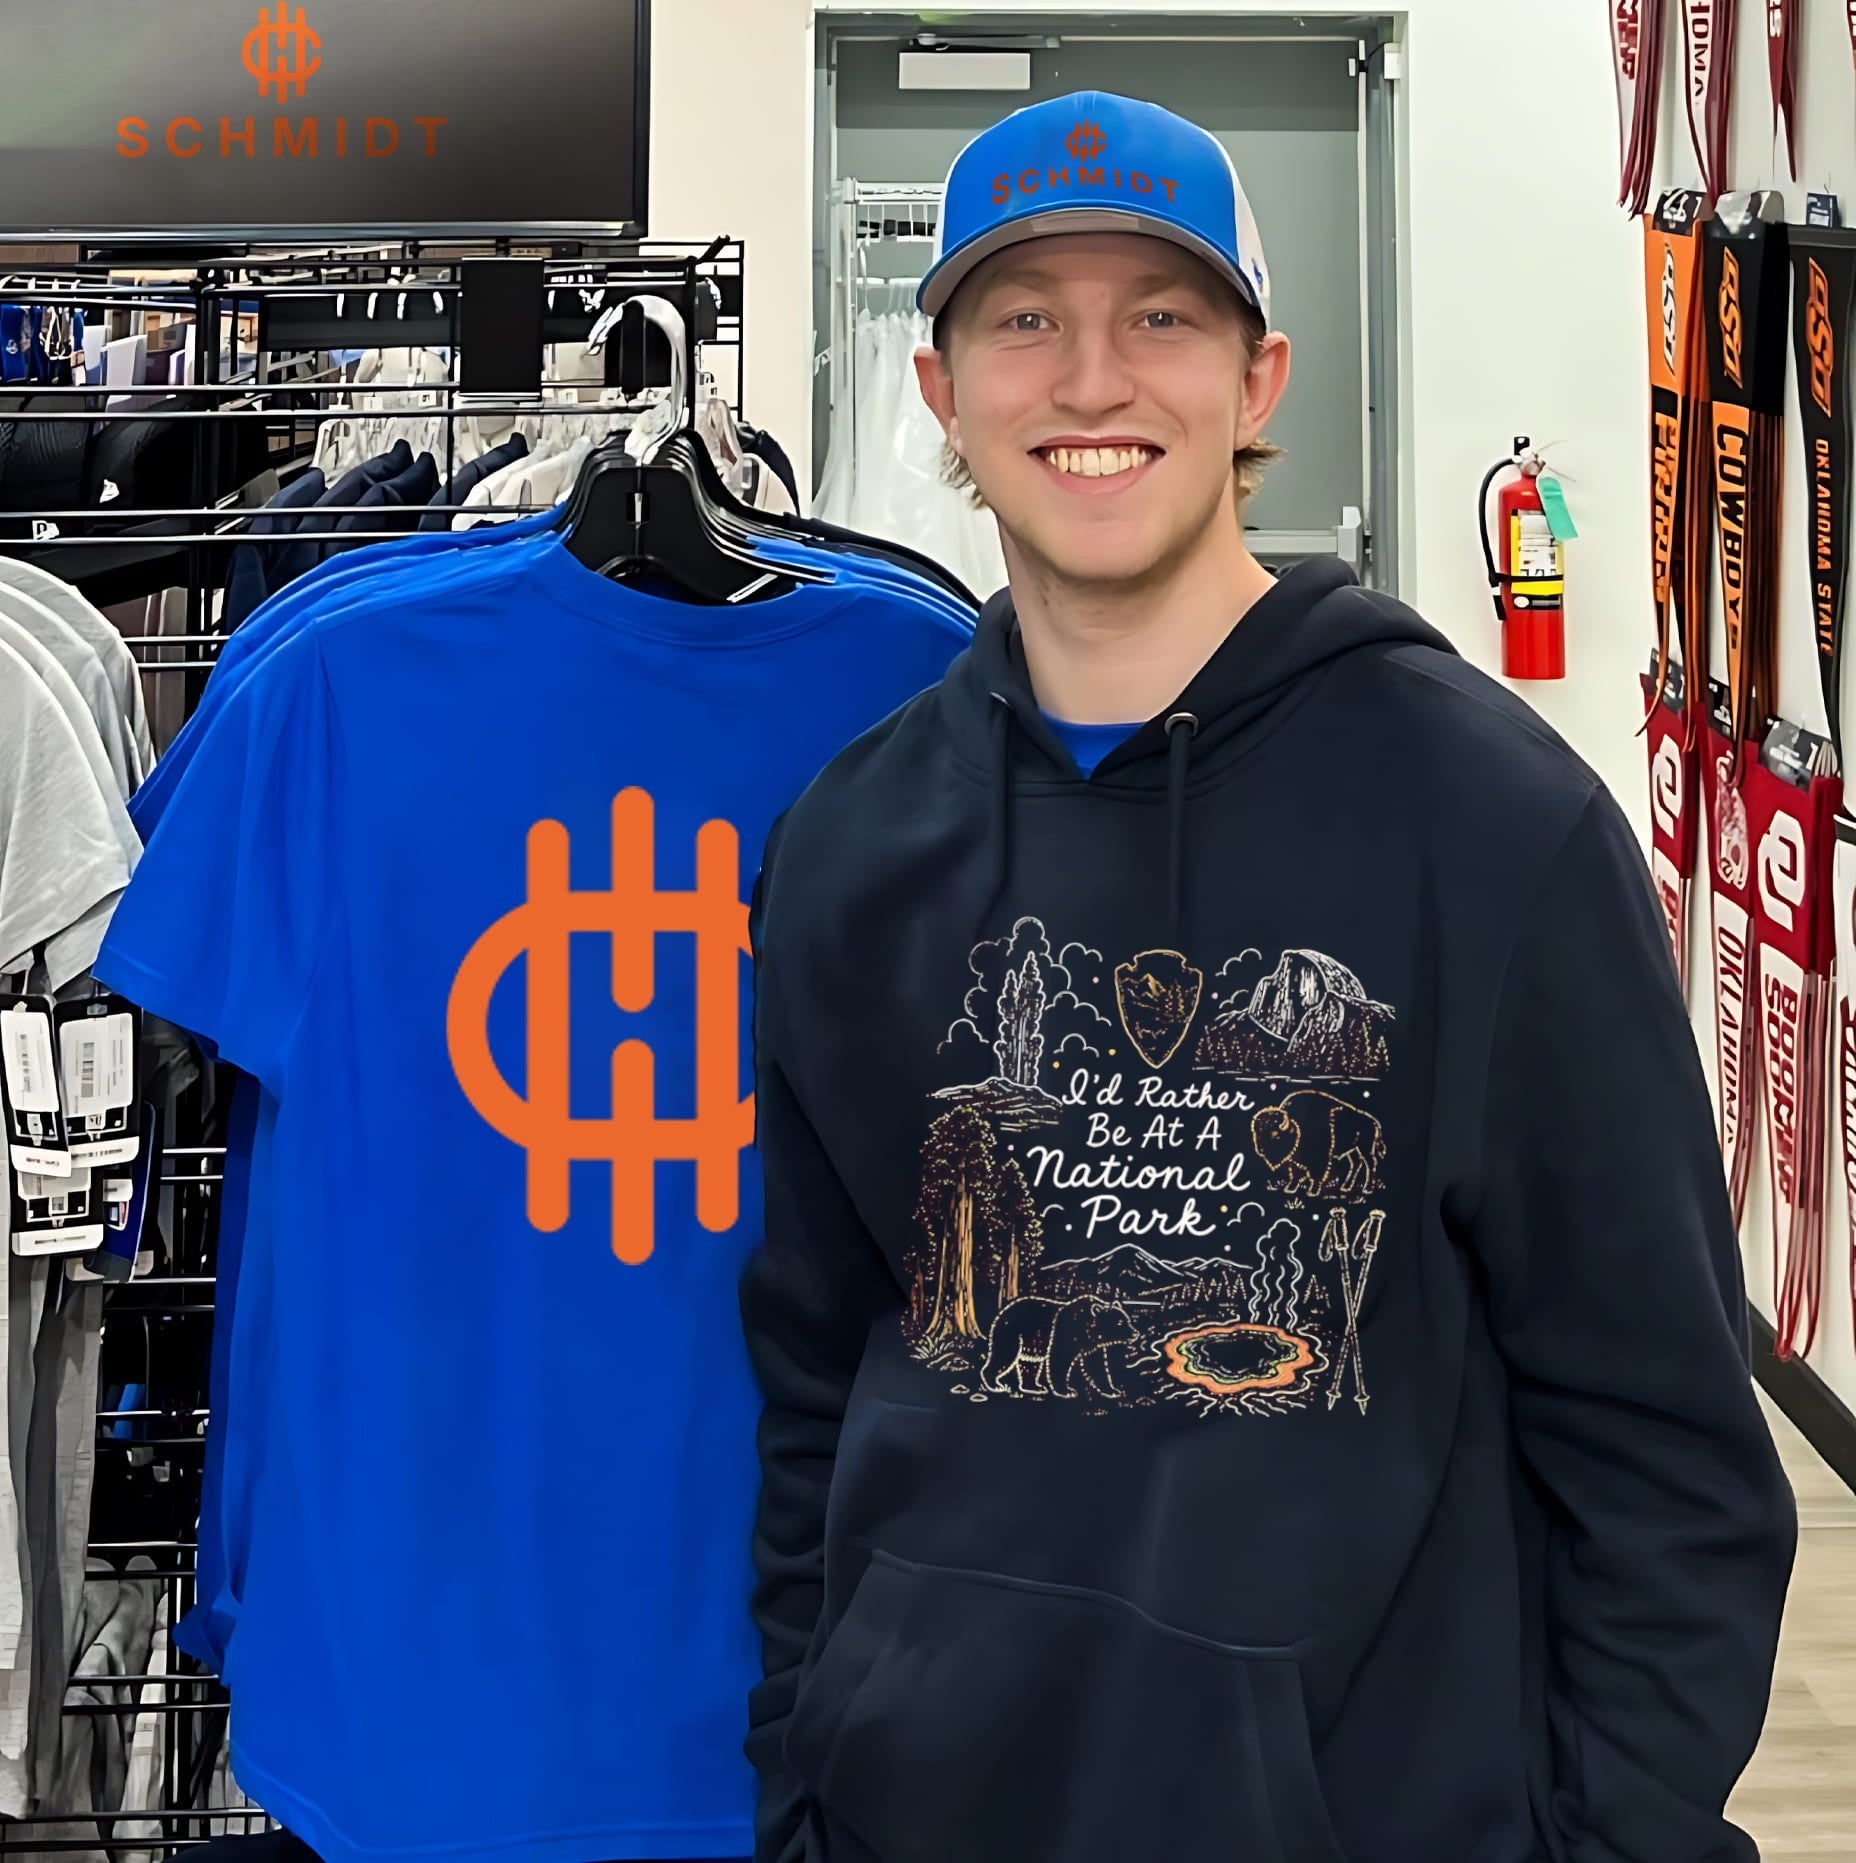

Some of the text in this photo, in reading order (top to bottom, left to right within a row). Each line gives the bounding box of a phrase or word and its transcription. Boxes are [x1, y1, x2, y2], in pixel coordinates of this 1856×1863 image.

[115, 117, 447, 158] SCHMIDT
[991, 167, 1179, 205] SCHMIDT
[1815, 438, 1832, 570] OKLAHOMA
[1718, 925, 1745, 1145] OKLAHOMA
[1062, 1068, 1255, 1111] I'd Rather
[1086, 1112, 1222, 1151] Be At A
[1026, 1146, 1251, 1191] National
[1080, 1194, 1217, 1239] Park
